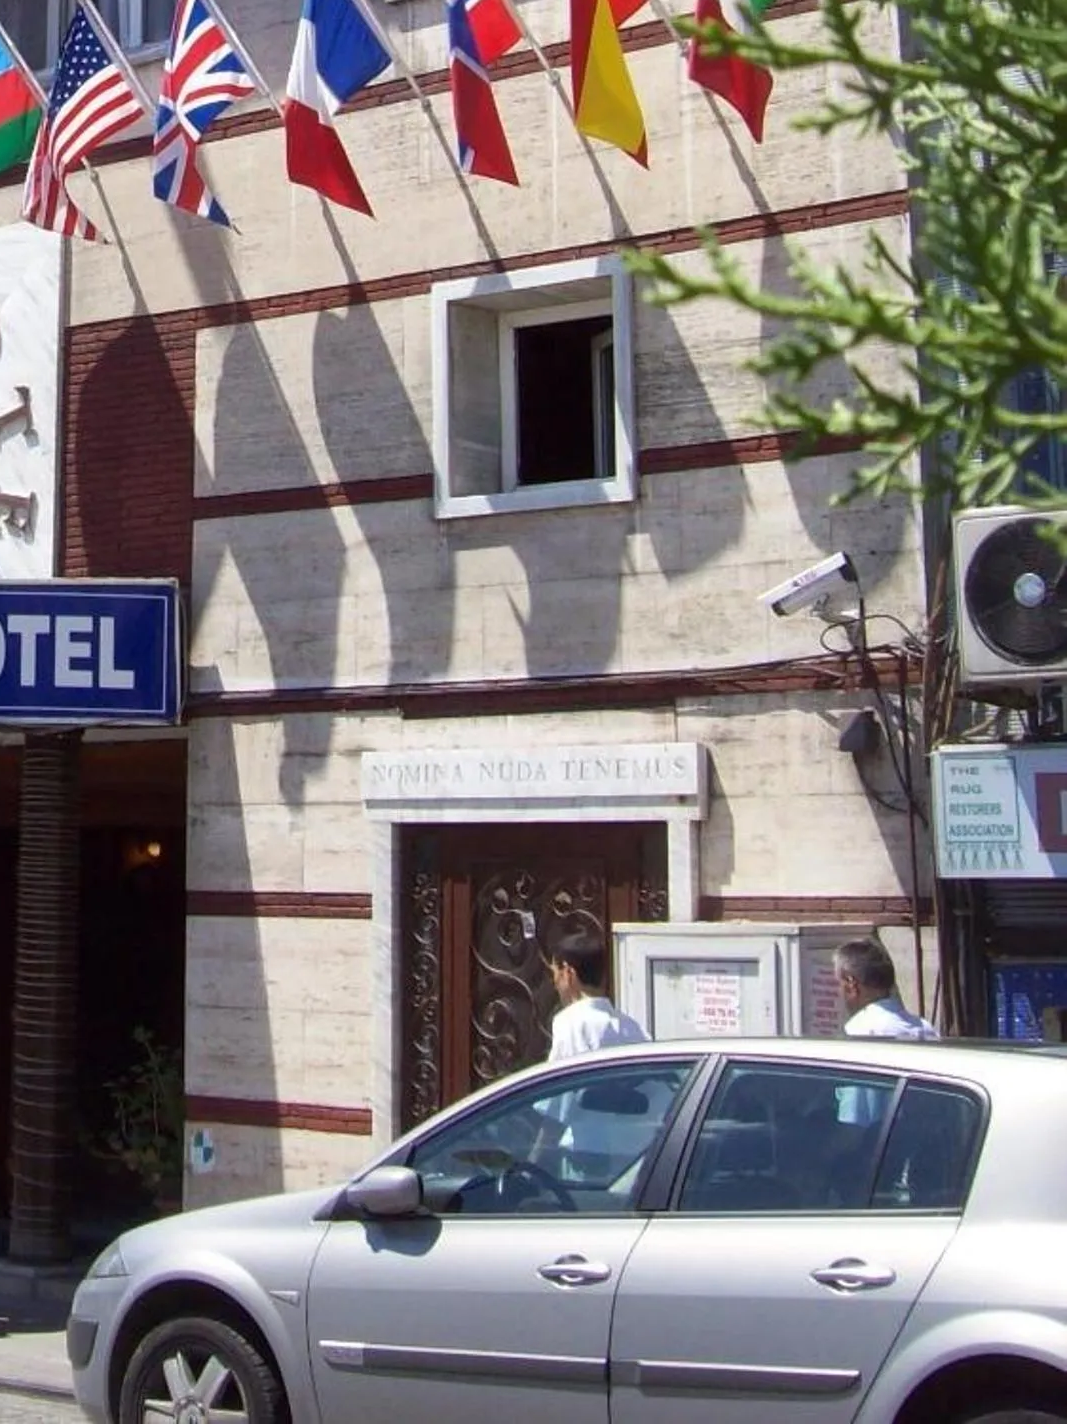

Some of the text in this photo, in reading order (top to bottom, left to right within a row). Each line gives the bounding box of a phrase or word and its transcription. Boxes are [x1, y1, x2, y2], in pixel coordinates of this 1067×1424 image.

[370, 754, 687, 786] NOMINA NUDA TENEMUS
[949, 766, 981, 777] THE
[950, 783, 983, 795] RUG
[949, 803, 1002, 816] RESTORERS
[949, 824, 1015, 837] ASSOCIATION
